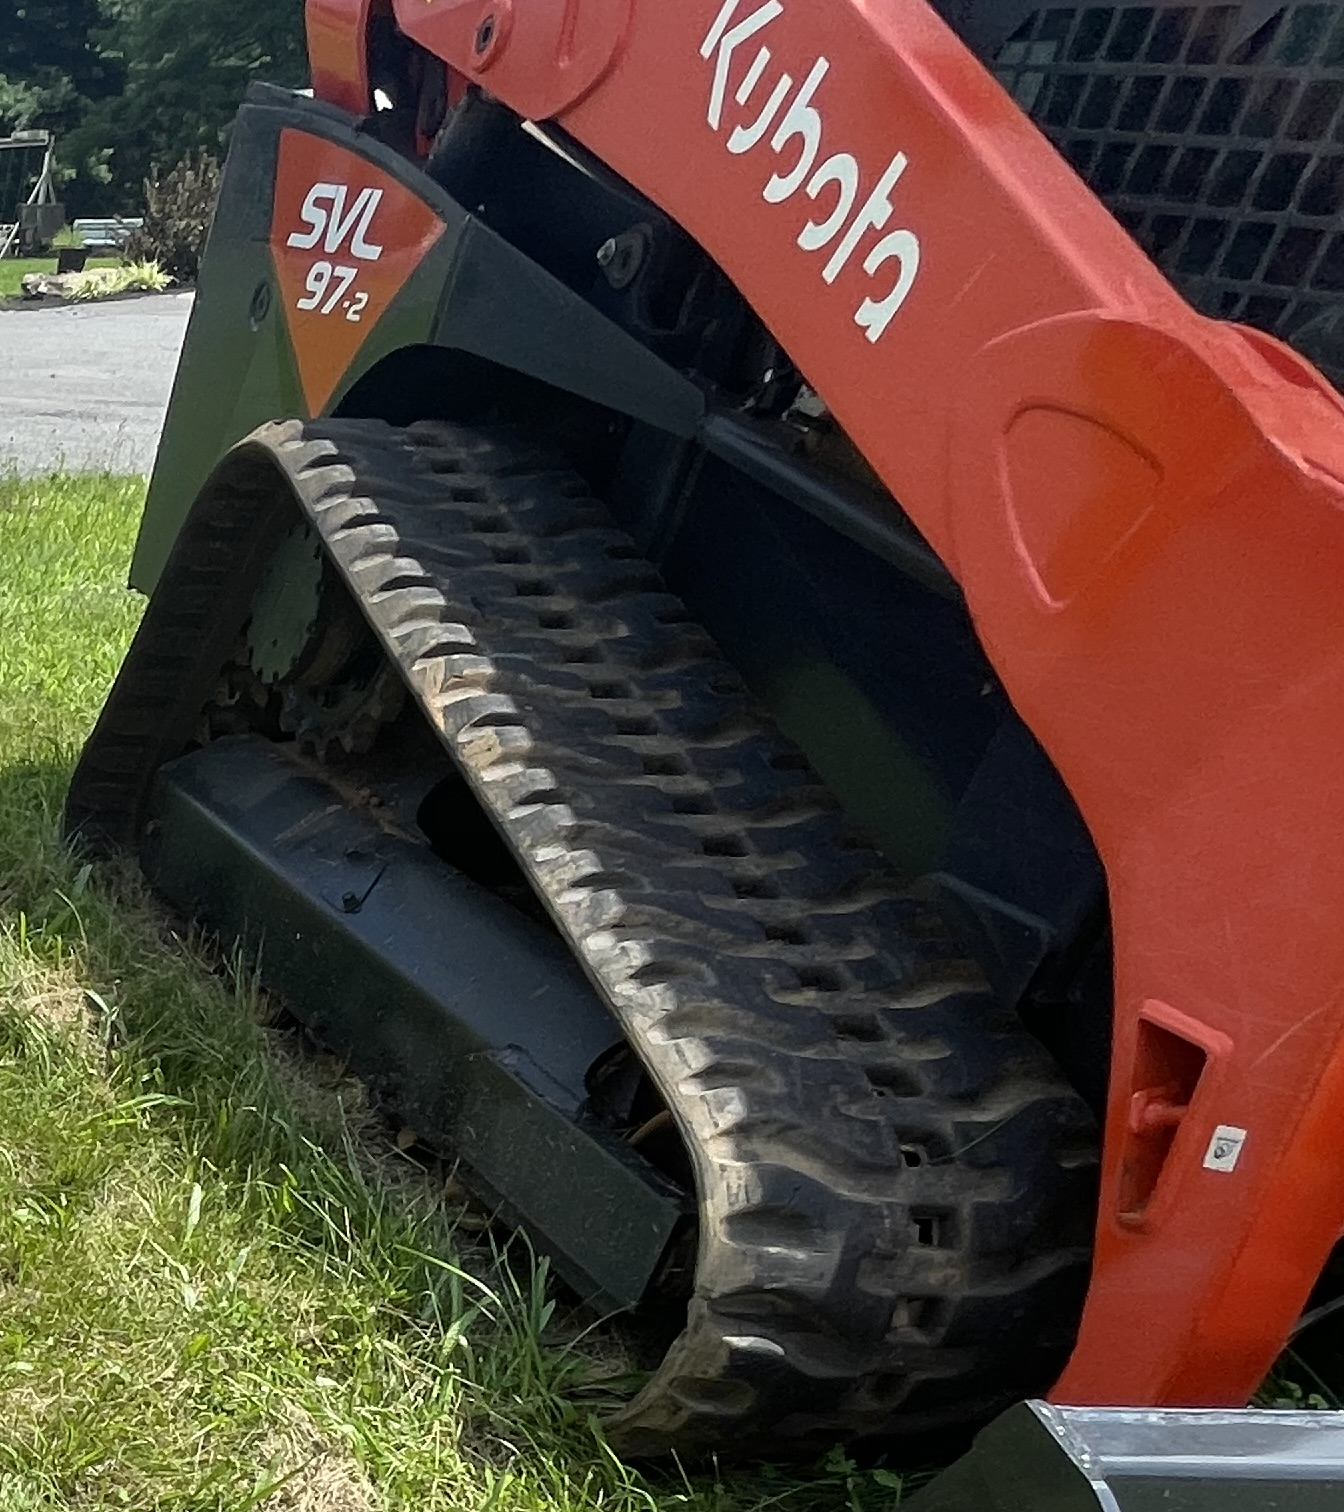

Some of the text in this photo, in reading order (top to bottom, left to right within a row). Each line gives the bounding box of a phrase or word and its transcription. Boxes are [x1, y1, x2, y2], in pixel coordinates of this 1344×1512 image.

[700, 0, 920, 344] Kubota
[286, 182, 384, 260] SVL
[296, 261, 369, 322] 97-2
